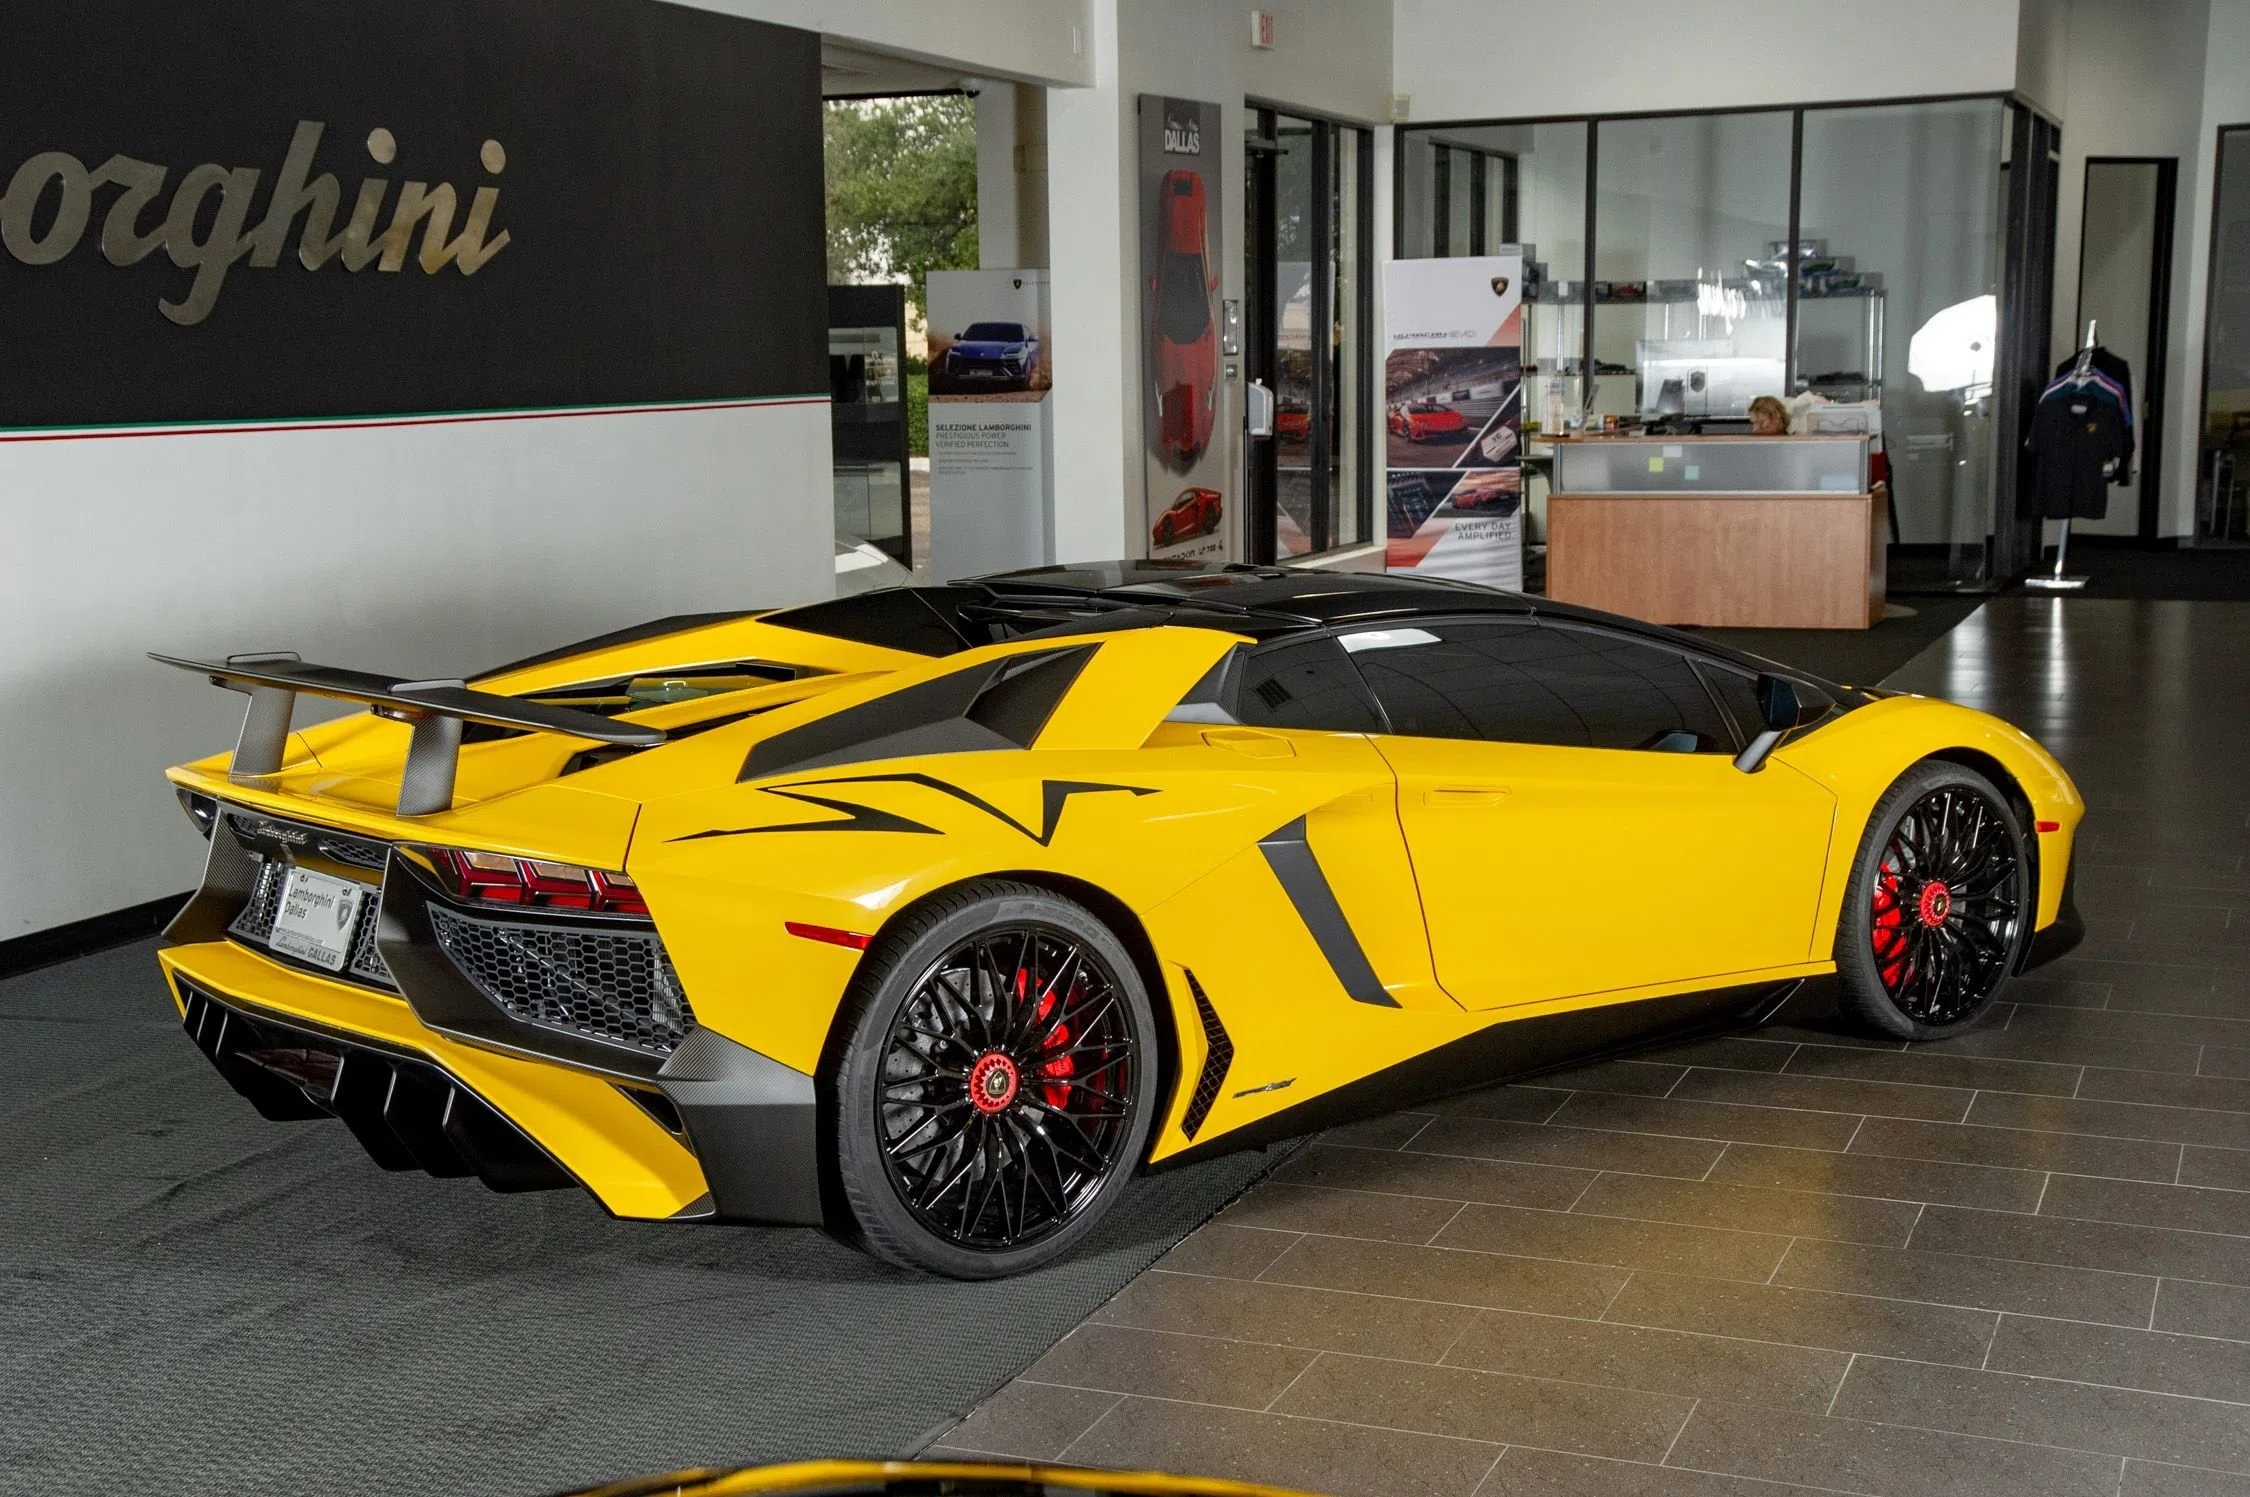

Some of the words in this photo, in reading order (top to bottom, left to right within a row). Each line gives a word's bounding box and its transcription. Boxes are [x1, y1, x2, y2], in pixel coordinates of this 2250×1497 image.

[1165, 129, 1200, 153] DALLAS
[0, 120, 511, 326] orghini
[935, 424, 977, 432] SELEZIONE
[979, 424, 1032, 432] LAMBORGHINI
[935, 440, 966, 448] VERIFIED
[967, 440, 1009, 448] PERFECTION
[1455, 522, 1487, 531] EVERY
[1491, 522, 1511, 530] DAY
[1458, 531, 1511, 540] AMPLIFIED
[288, 884, 335, 909] Lamborghini
[284, 901, 308, 919] Dallas
